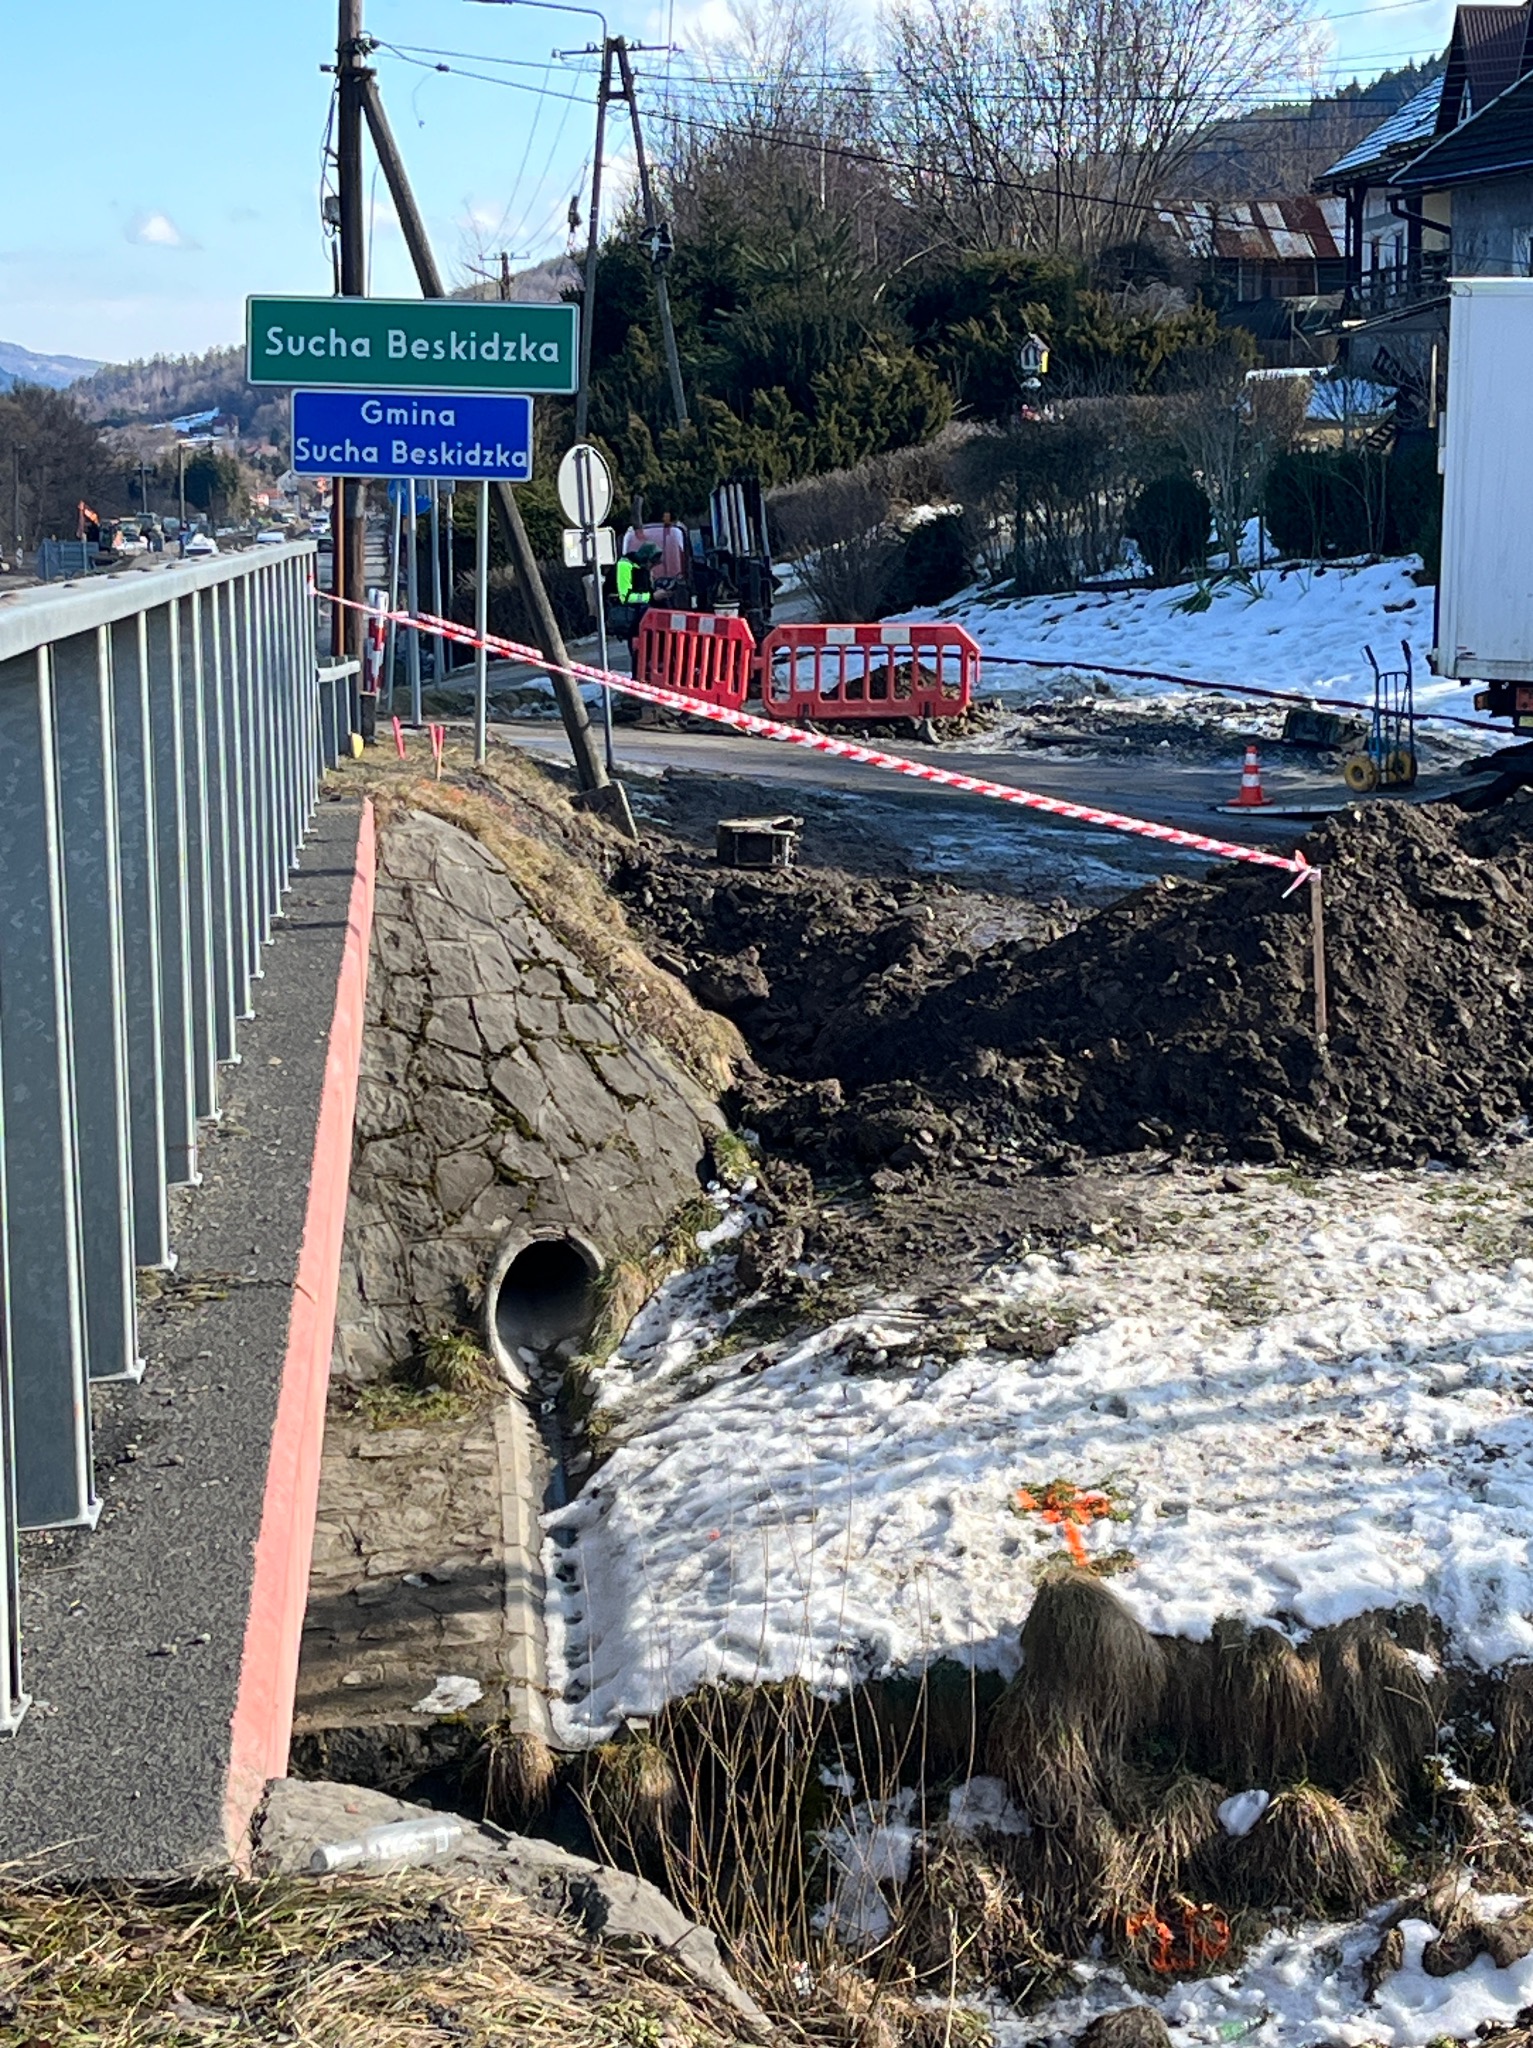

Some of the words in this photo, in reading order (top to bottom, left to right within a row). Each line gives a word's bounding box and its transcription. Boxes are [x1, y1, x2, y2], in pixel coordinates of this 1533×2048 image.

[265, 327, 371, 358] Sucha
[388, 329, 559, 363] Beskidzka
[361, 400, 455, 426] Gmina
[295, 437, 378, 463] Sucha
[392, 440, 527, 468] Beskidzka
